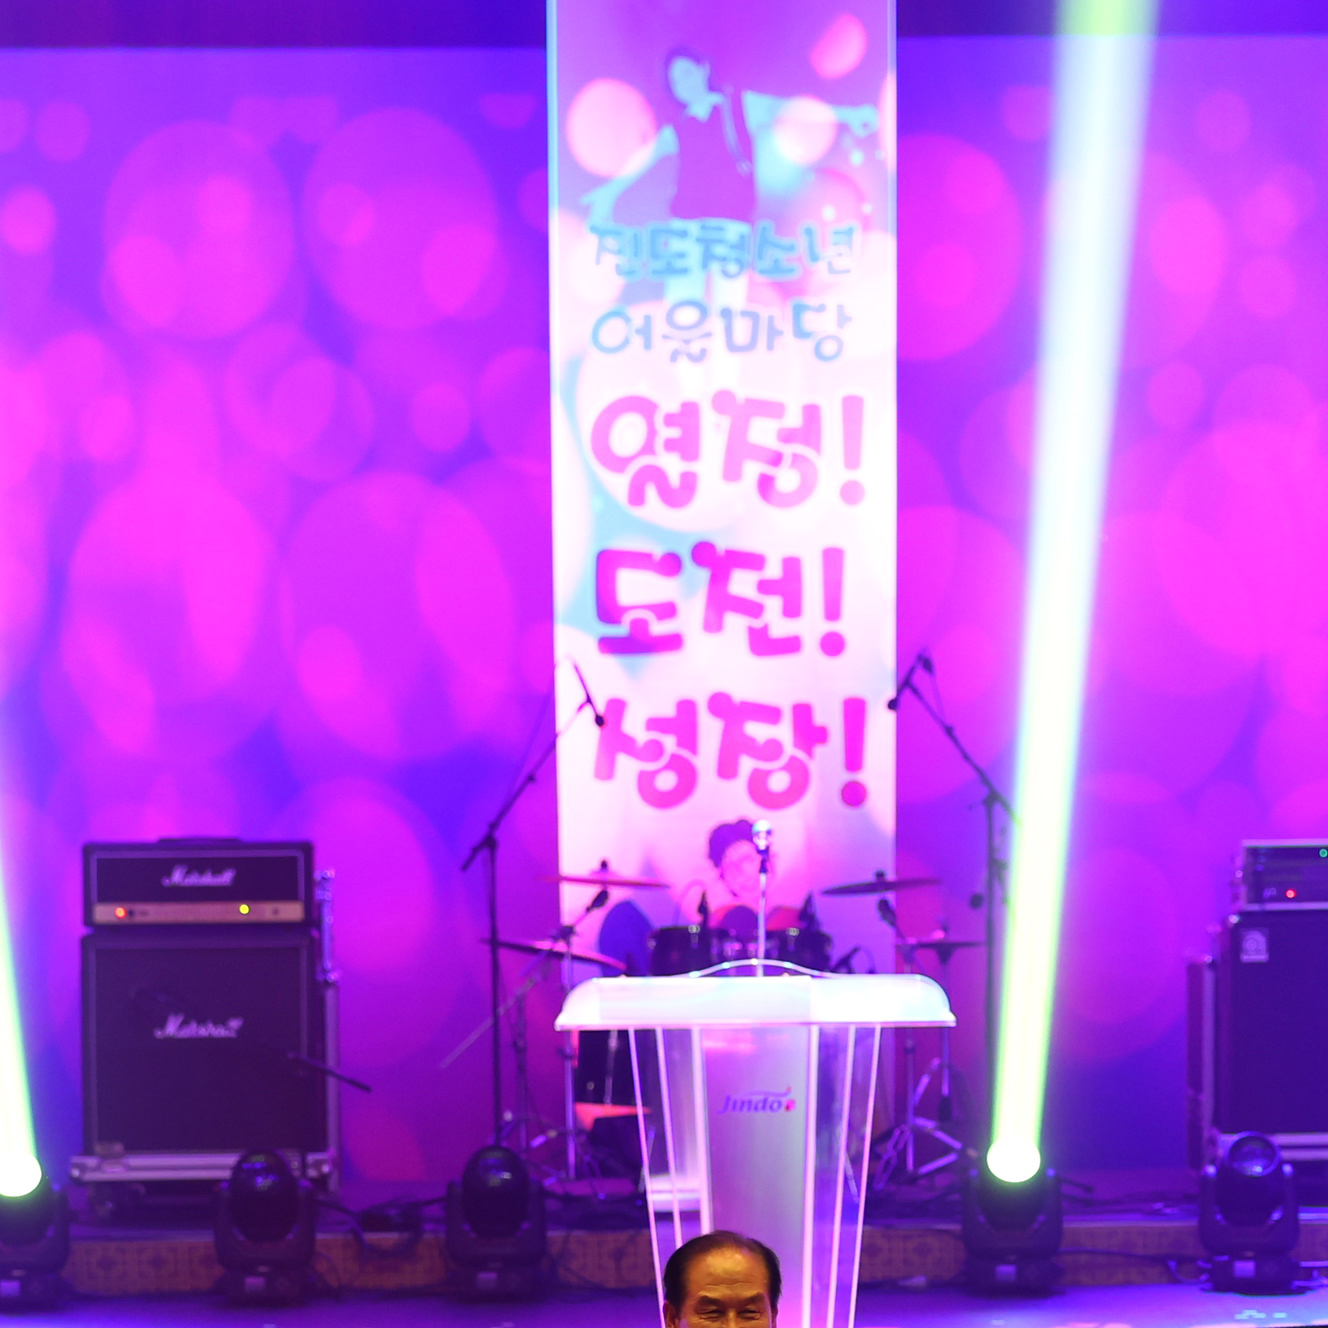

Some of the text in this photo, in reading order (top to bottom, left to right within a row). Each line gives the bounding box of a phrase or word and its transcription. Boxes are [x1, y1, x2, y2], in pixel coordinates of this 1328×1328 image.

[591, 300, 853, 363] 어울마당
[590, 389, 866, 509] 열정!
[595, 541, 846, 657] 도전!
[593, 692, 867, 811] 성장!
